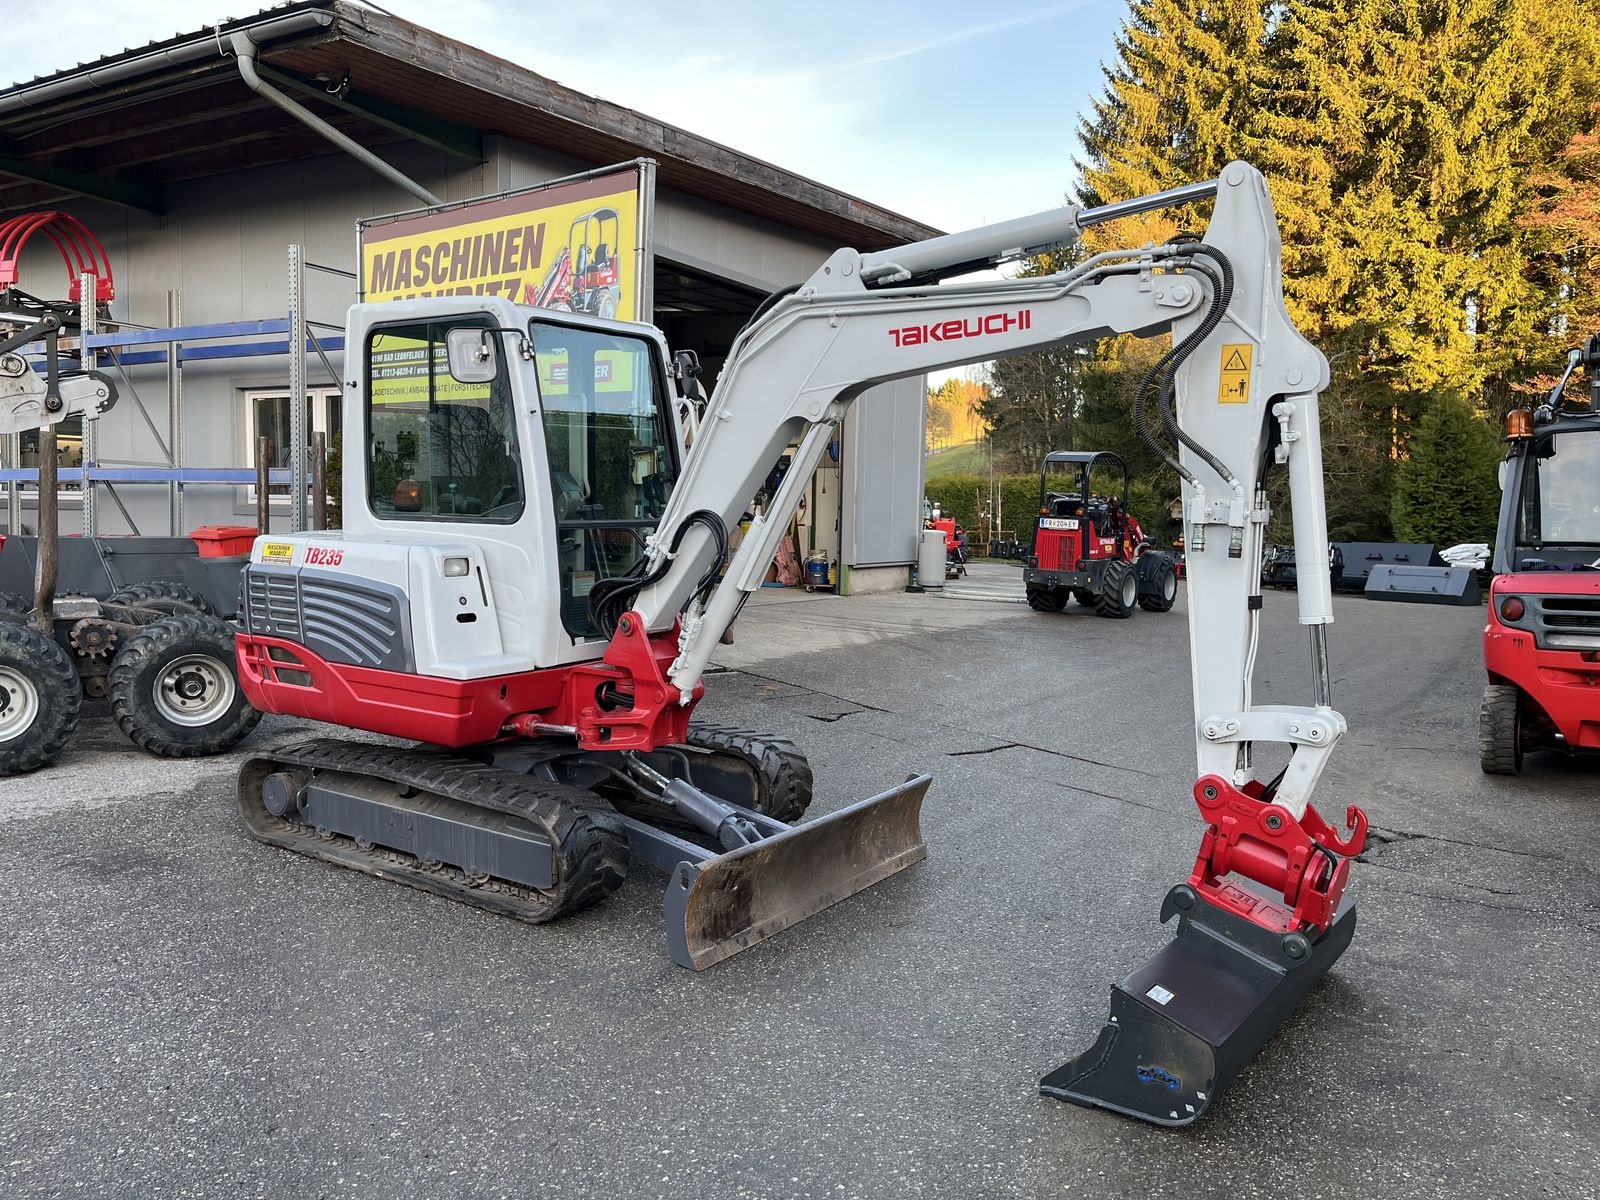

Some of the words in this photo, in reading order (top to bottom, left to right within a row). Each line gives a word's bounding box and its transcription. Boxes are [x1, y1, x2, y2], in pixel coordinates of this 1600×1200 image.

[371, 223, 546, 294] MASCHINEN
[888, 309, 1031, 347] TAKEUCHI
[383, 353, 394, 362] BAD
[394, 349, 425, 360] LEONFELDEN
[305, 547, 344, 566] TB235
